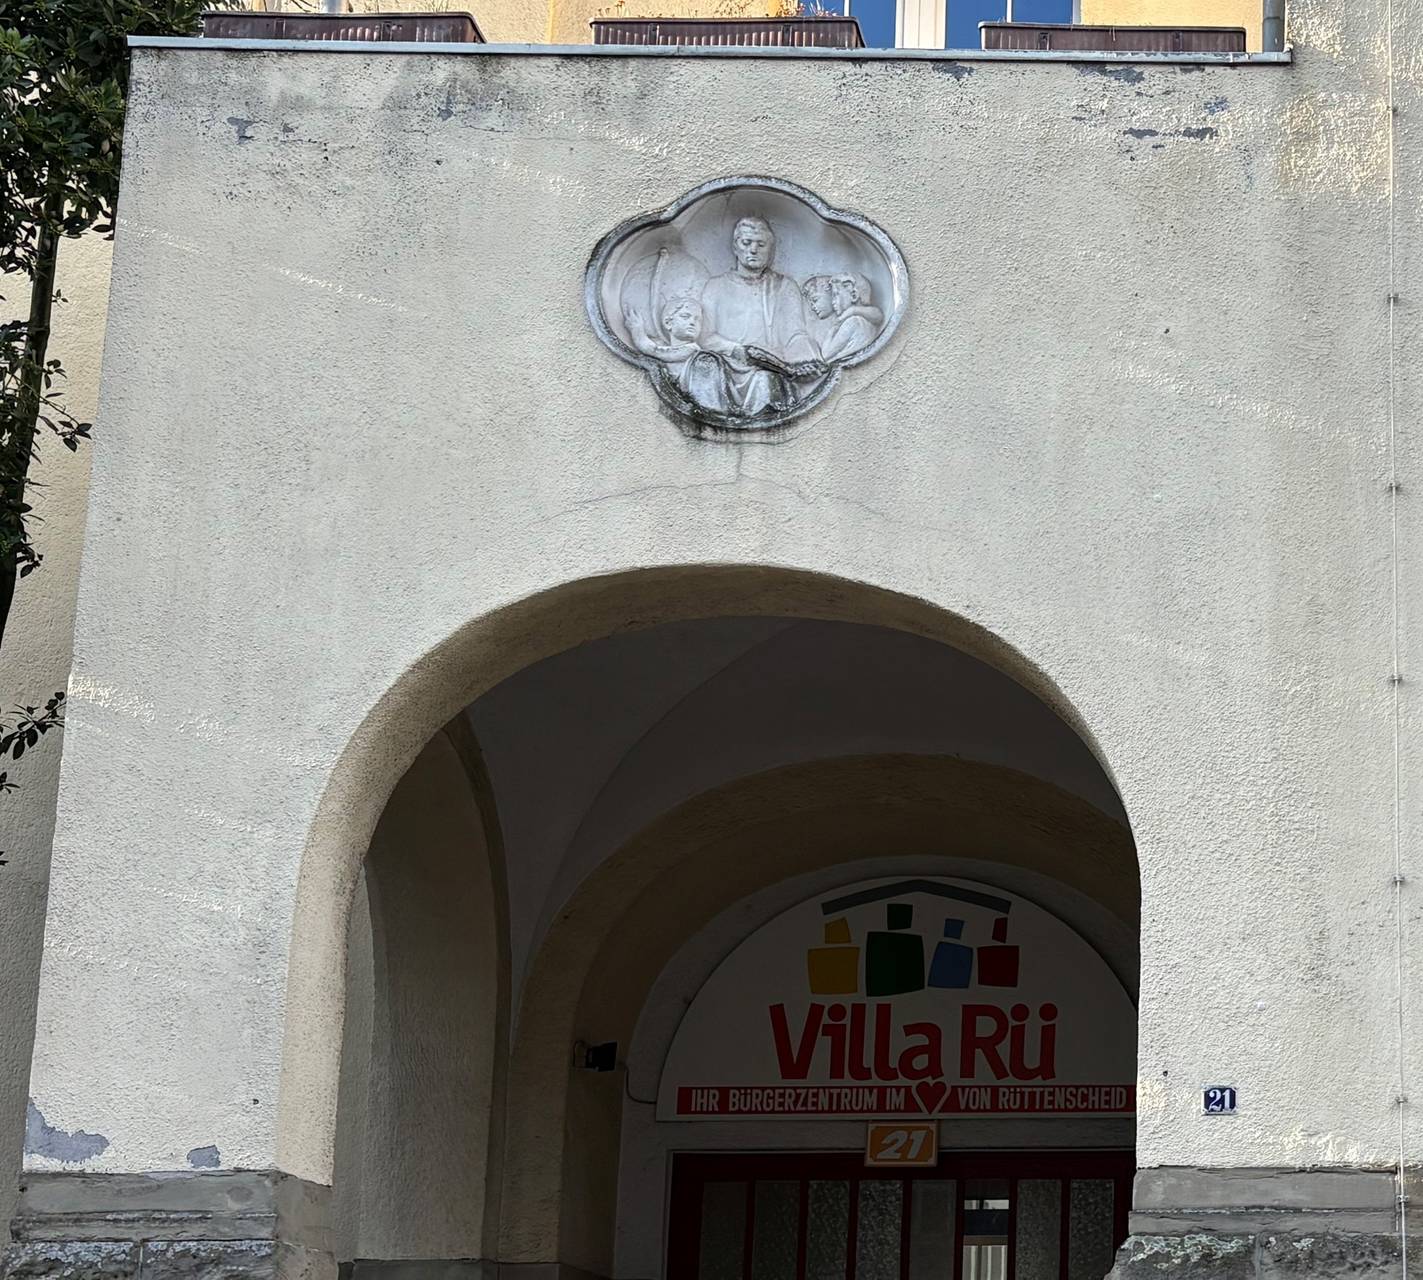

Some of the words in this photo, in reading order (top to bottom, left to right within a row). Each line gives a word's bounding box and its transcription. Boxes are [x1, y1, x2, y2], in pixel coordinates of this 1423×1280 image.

[769, 1003, 944, 1081] Villa
[960, 1003, 1058, 1081] Rü
[691, 1088, 719, 1112] IHR
[729, 1088, 877, 1111] BÜRGERZENTRUM
[886, 1087, 904, 1111] IM
[957, 1087, 991, 1110] VON
[999, 1087, 1127, 1110] RÜTTENSCHEID
[1208, 1089, 1231, 1112] 21
[877, 1130, 928, 1159] 21
